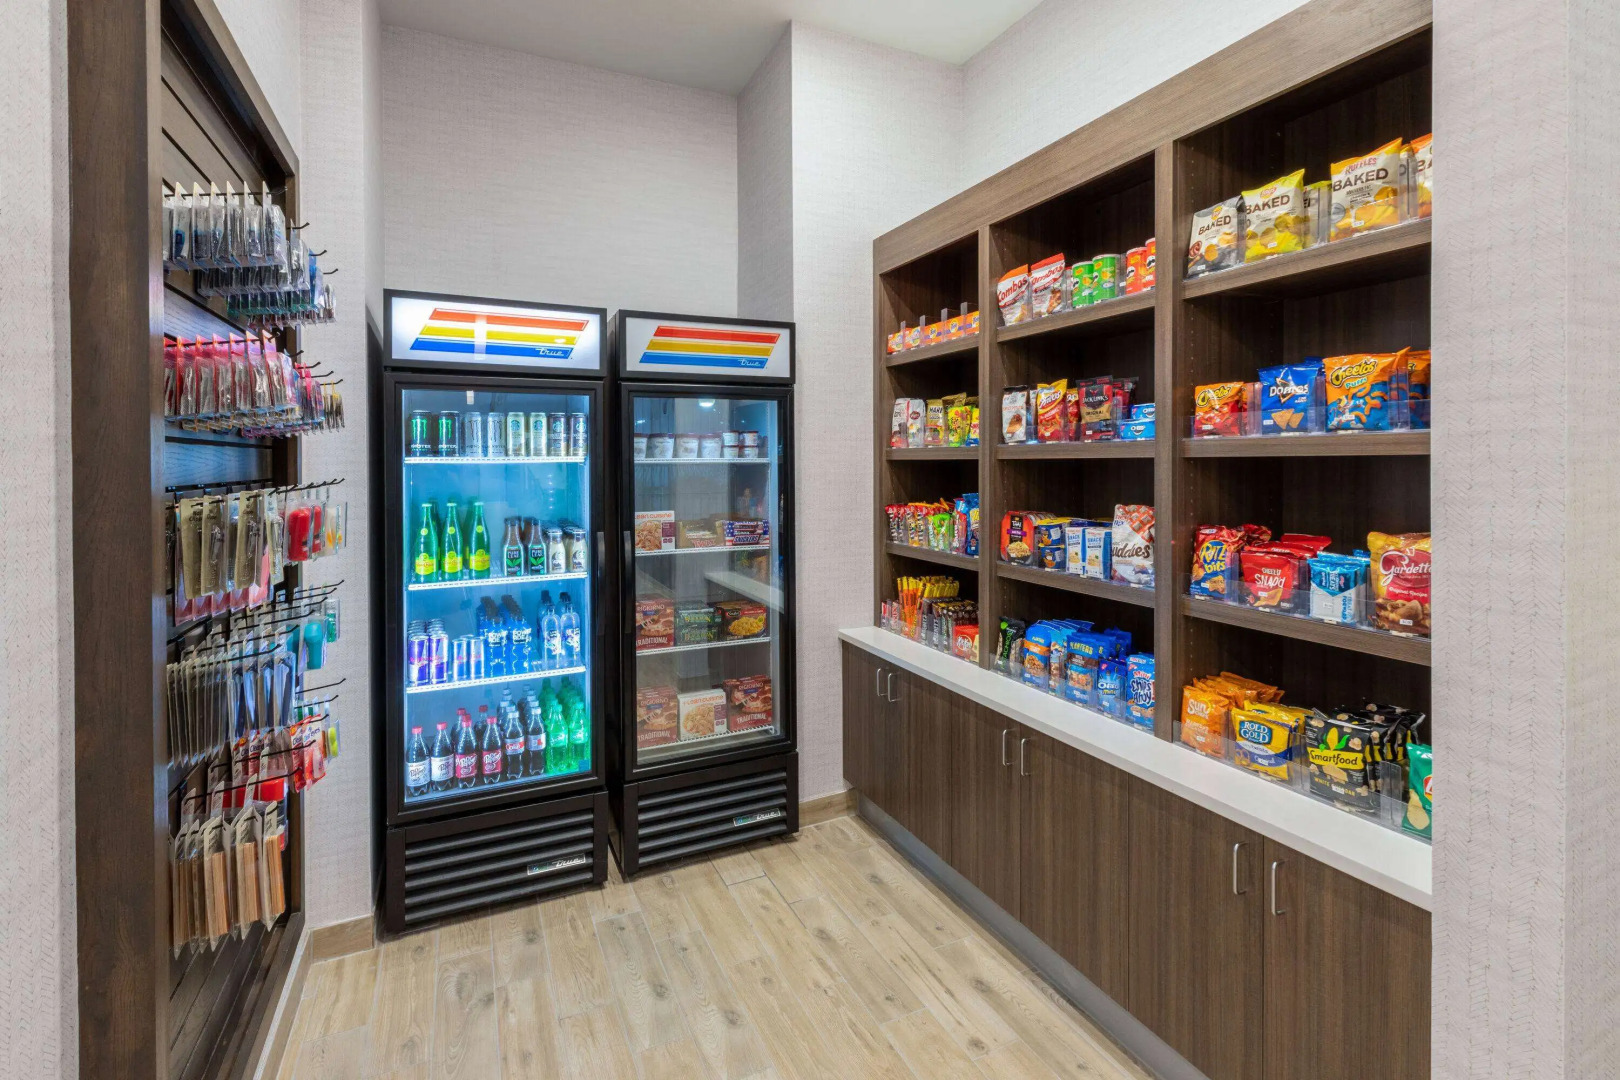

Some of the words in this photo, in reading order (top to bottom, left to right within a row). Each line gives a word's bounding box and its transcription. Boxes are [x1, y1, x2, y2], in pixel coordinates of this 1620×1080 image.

[1333, 168, 1388, 192] BAKED
[1246, 194, 1290, 214] BAKED
[1198, 215, 1231, 236] BAKED
[1330, 360, 1378, 387] Cheetos
[1201, 543, 1227, 563] RITZ
[1204, 561, 1226, 573] bits
[1241, 729, 1269, 743] GOLD
[1244, 722, 1269, 733] ROLD
[1309, 750, 1358, 766] Smartfood
